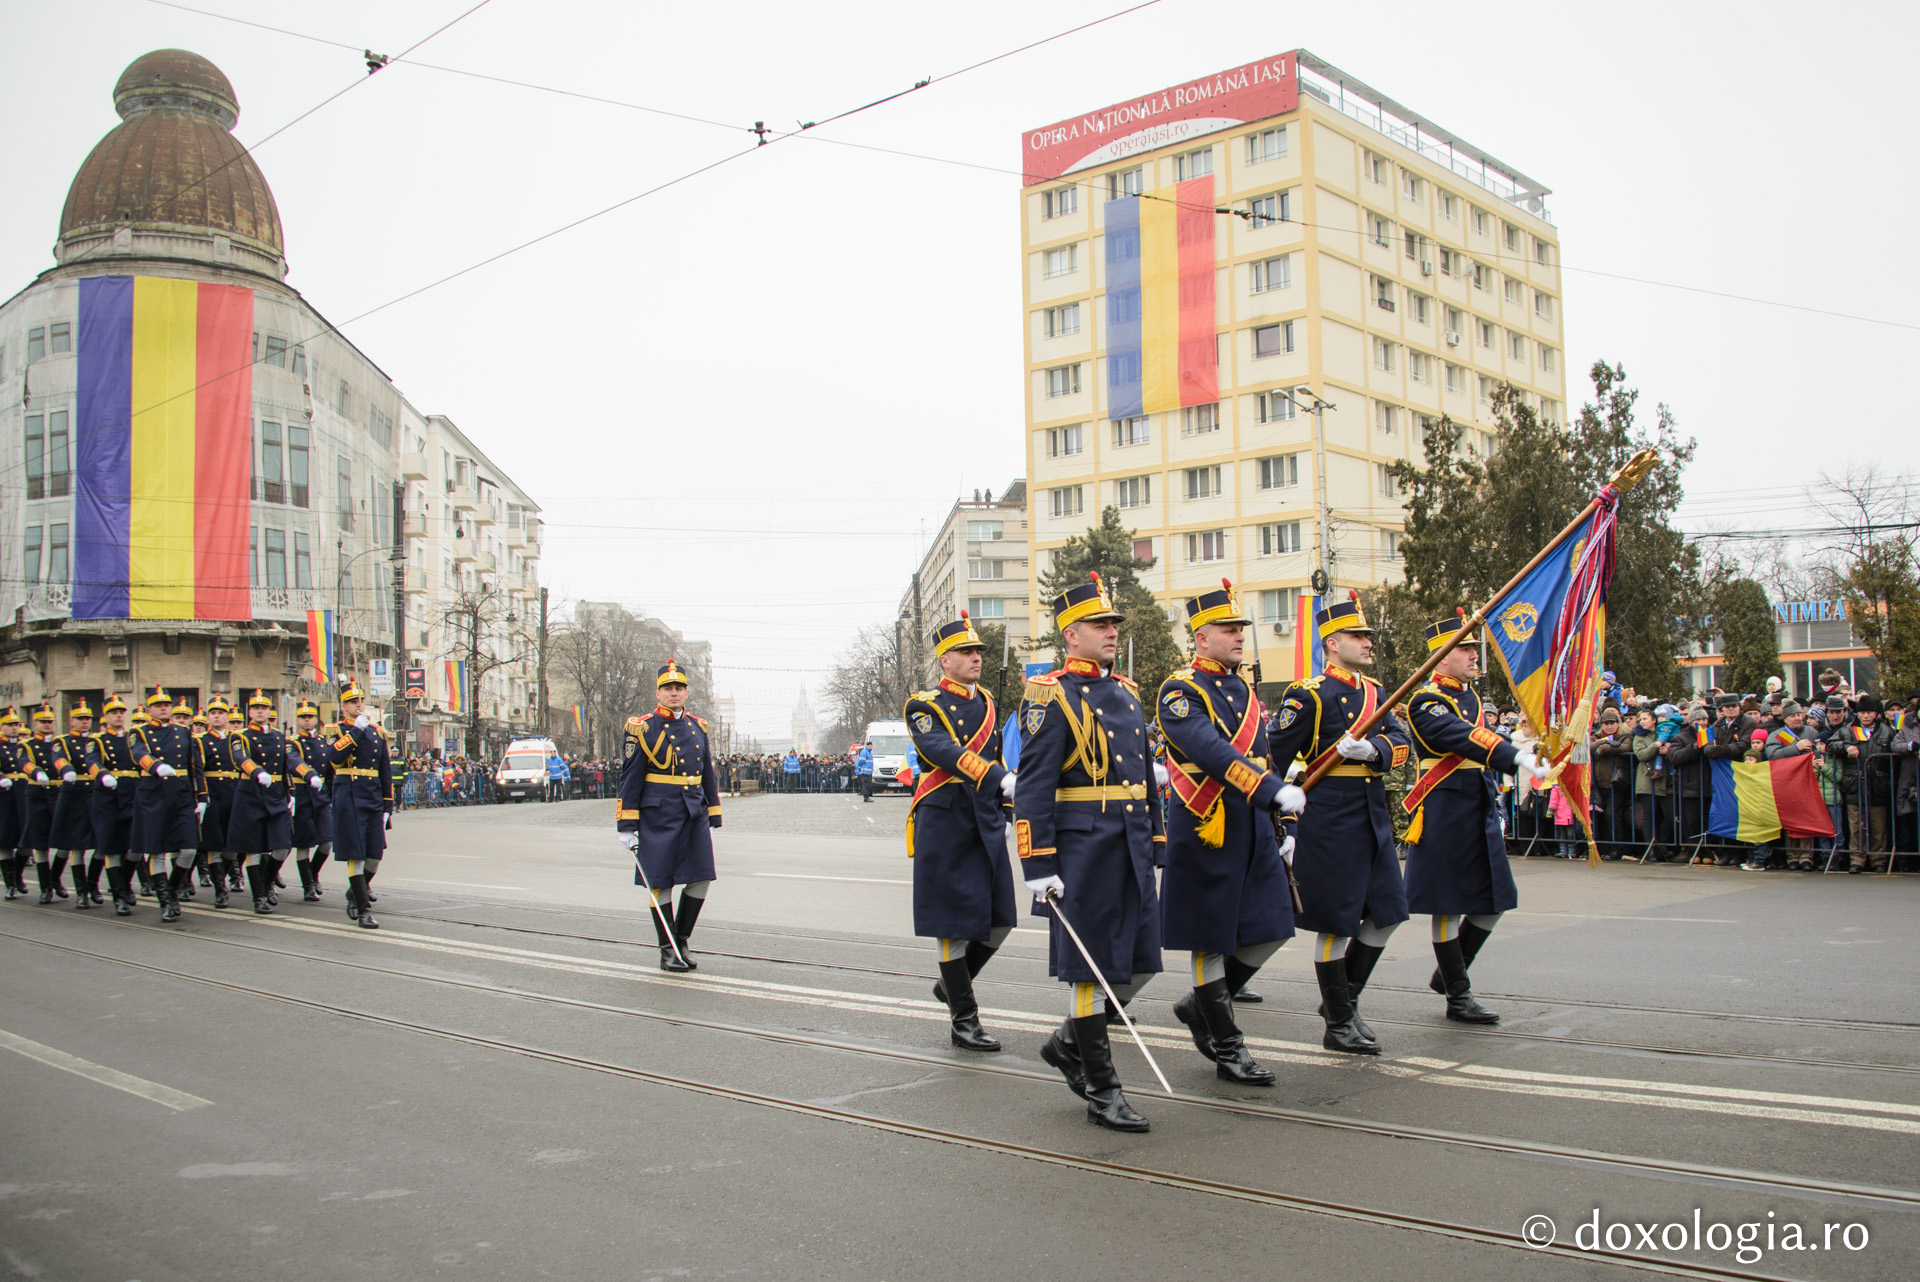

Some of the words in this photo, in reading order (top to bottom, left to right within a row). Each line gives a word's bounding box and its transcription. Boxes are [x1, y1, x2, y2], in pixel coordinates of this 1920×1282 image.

[1030, 123, 1080, 150] OPERA
[1110, 123, 1189, 155] operaiasi.ro
[1770, 599, 1847, 624] NIMEA
